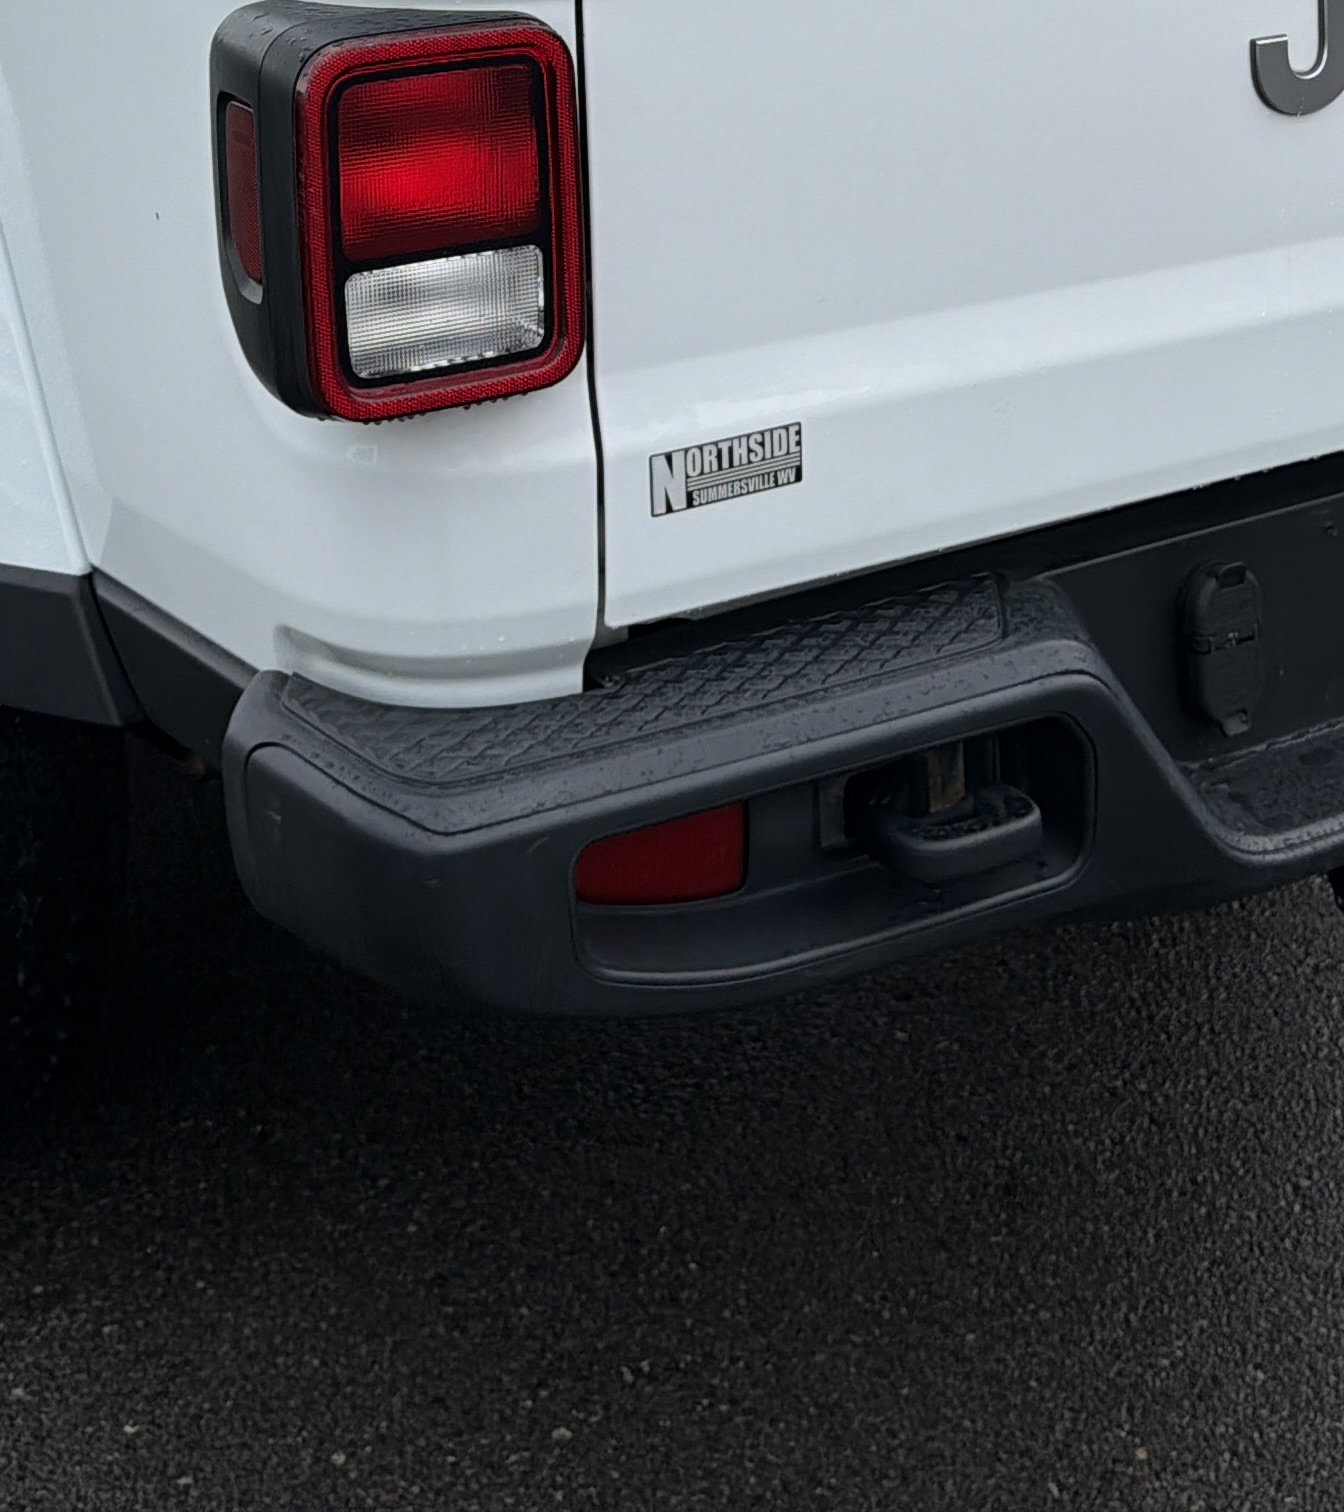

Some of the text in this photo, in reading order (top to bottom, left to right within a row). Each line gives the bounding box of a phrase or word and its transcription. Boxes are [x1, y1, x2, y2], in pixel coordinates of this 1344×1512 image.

[651, 424, 801, 515] NORTHSIDE
[692, 467, 797, 506] SUMMERSVILLE WV
